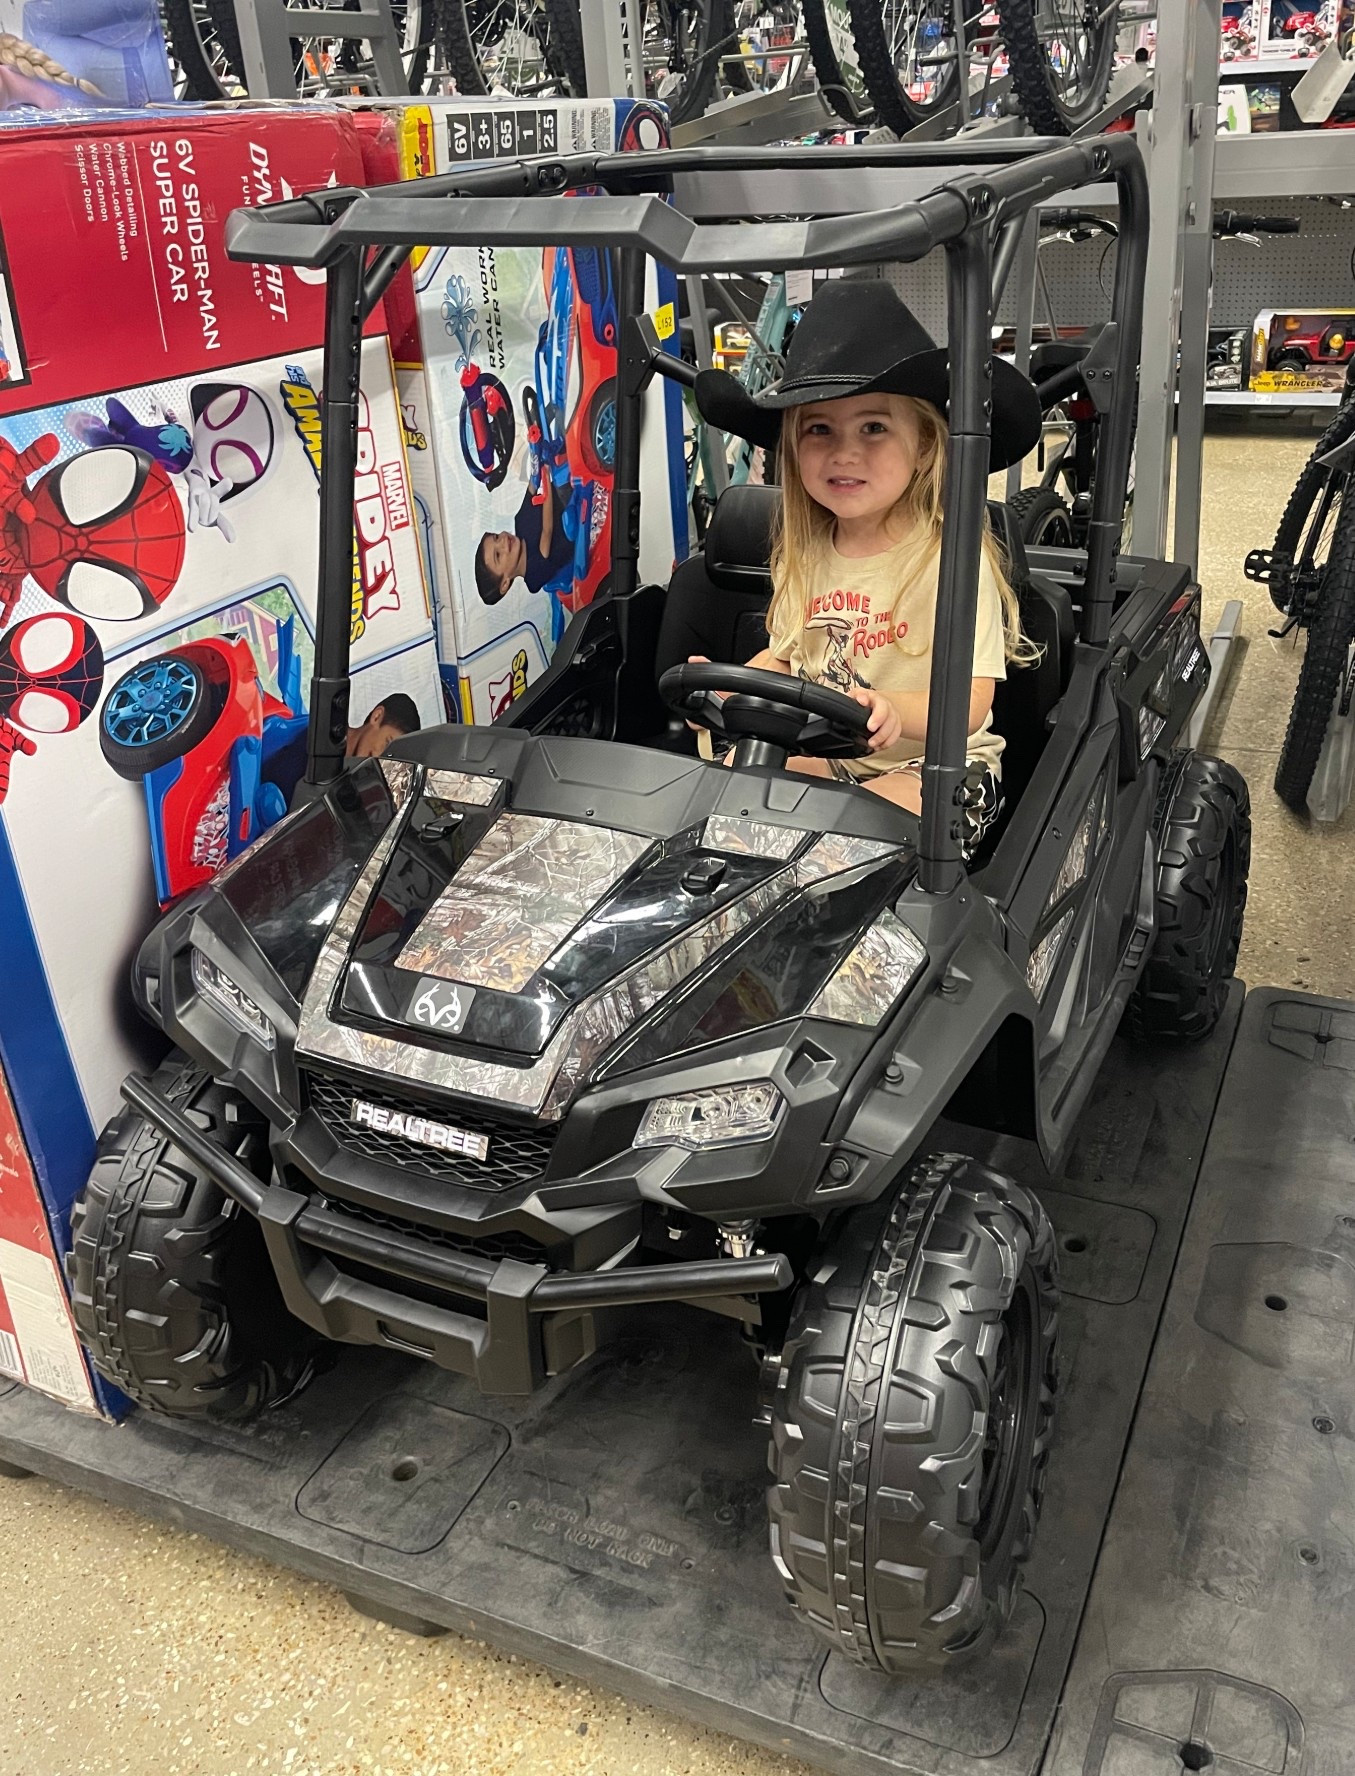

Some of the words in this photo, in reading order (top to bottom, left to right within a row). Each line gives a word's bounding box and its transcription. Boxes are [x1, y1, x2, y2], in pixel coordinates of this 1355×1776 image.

[453, 122, 468, 154] 6V
[478, 118, 491, 150] 3+
[501, 119, 513, 149] 65
[522, 129, 534, 140] 1
[543, 114, 555, 148] 2.5
[175, 138, 196, 175] 6V
[74, 144, 89, 186] Scissor
[83, 188, 95, 222] Doors
[88, 143, 101, 177] Water
[95, 179, 108, 222] Cannon
[116, 142, 131, 185] Webbed
[125, 188, 138, 237] Detailing
[241, 175, 251, 205] FUN
[103, 142, 122, 219] Chrome-Look
[116, 220, 129, 261] Wheels
[150, 140, 179, 236] SUPER
[165, 243, 189, 302] CAR
[182, 184, 220, 350] SPIDER-MAN
[486, 312, 496, 368] REAL
[492, 299, 505, 369] WATER
[657, 316, 672, 330] L152
[1273, 380, 1323, 388] WRANGLER
[382, 462, 409, 530] MARVEL
[855, 616, 869, 629] TO
[1181, 647, 1201, 682] REALTREE
[355, 1101, 481, 1160] REALTREE
[564, 1528, 603, 1549] NOT
